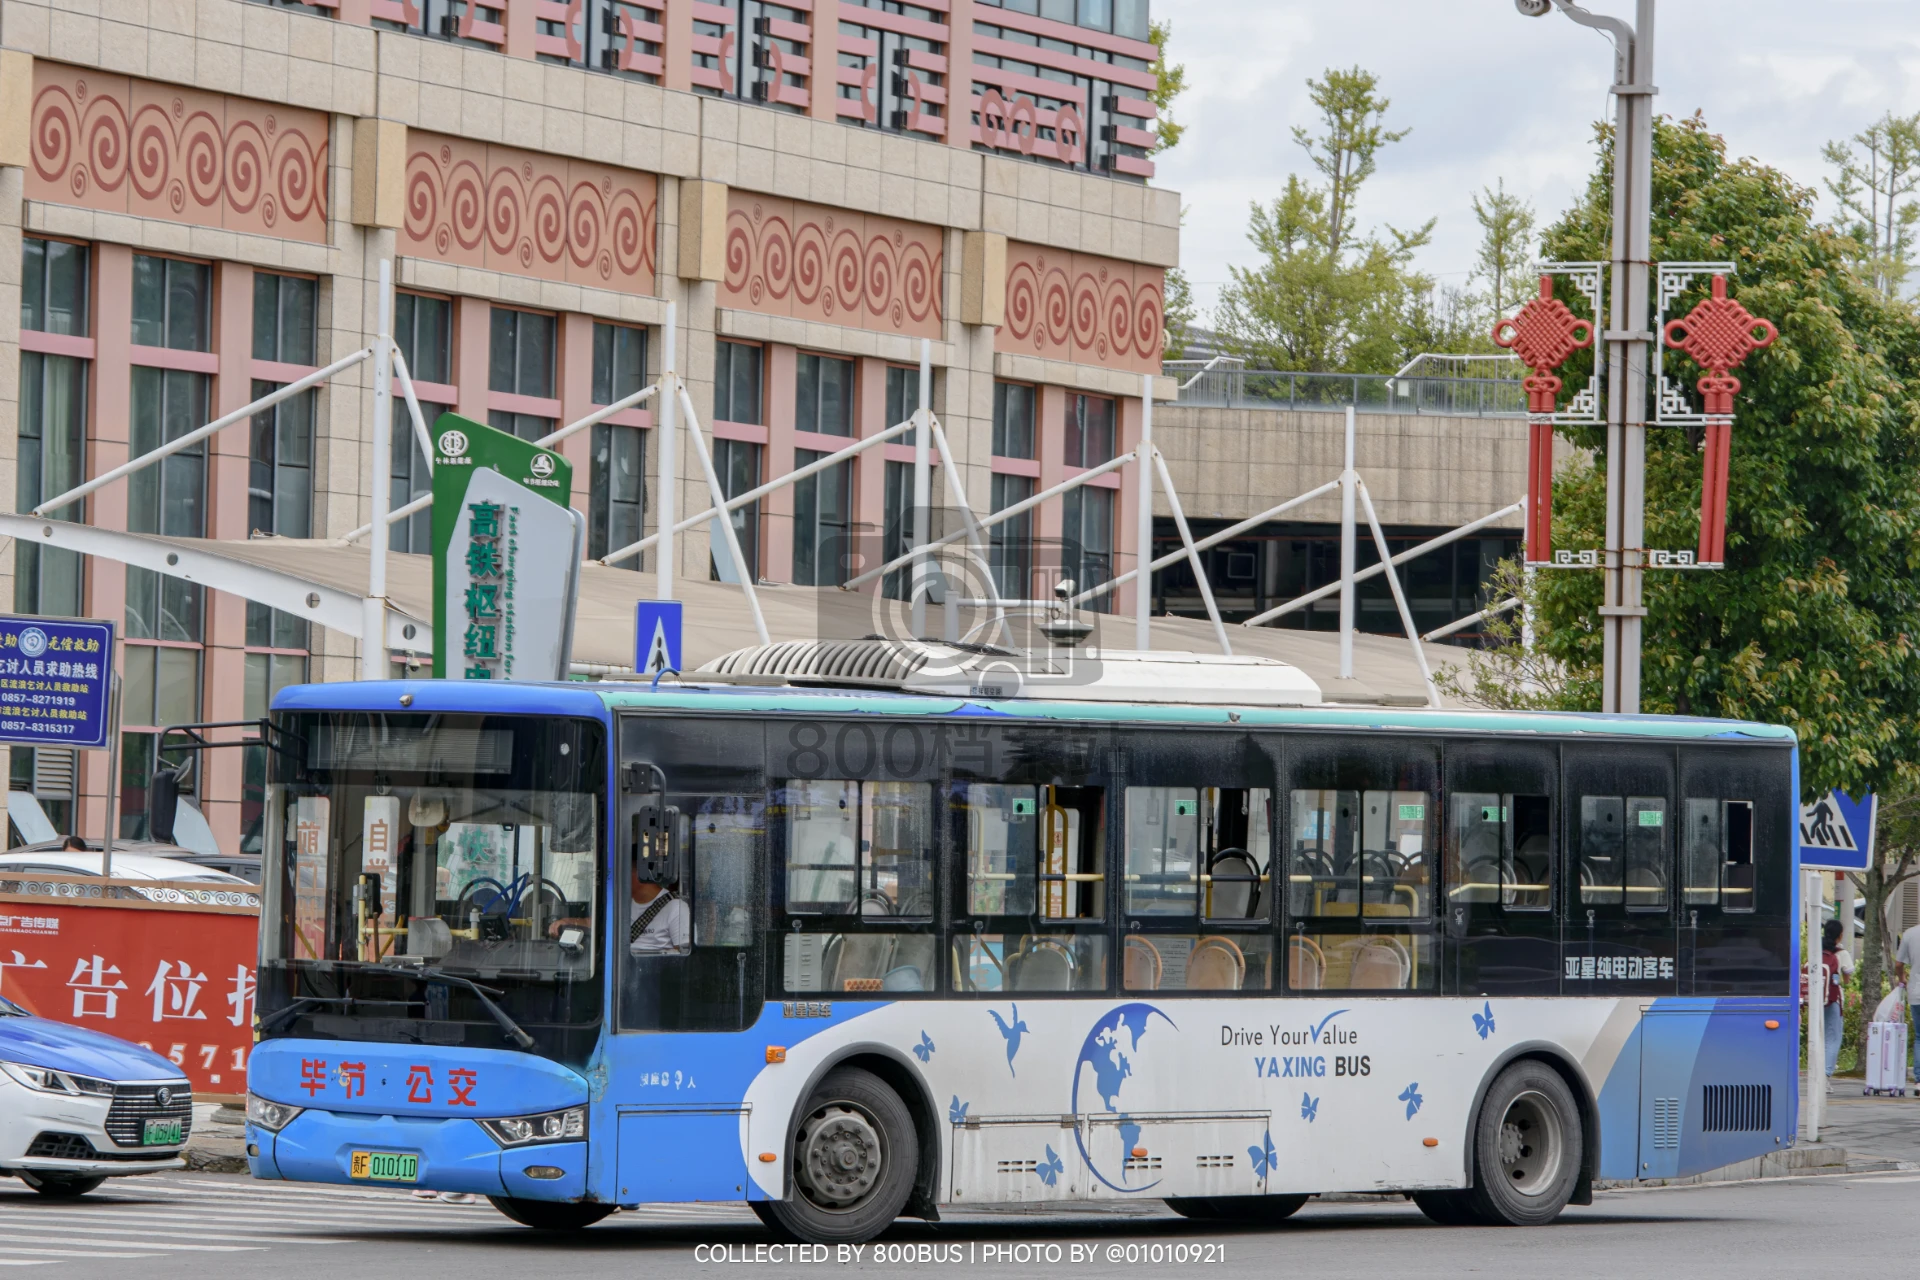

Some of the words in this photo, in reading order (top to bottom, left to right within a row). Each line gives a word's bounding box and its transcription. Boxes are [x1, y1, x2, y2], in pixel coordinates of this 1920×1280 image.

[509, 506, 519, 536] Fast
[504, 538, 518, 599] charging
[505, 602, 515, 652] station
[48, 636, 100, 653] 无偿救助
[1, 692, 76, 706] 0857-8271919
[1, 719, 75, 734] 0857-8315317
[1564, 956, 1674, 979] 亚星纯电动客车
[783, 1001, 832, 1018] 亚星客车
[1221, 1025, 1263, 1046] Drive
[1269, 1024, 1309, 1045] Your
[1254, 1056, 1326, 1078] YAXING
[1335, 1055, 1371, 1077] BUS
[299, 1058, 477, 1107] 毕节公交
